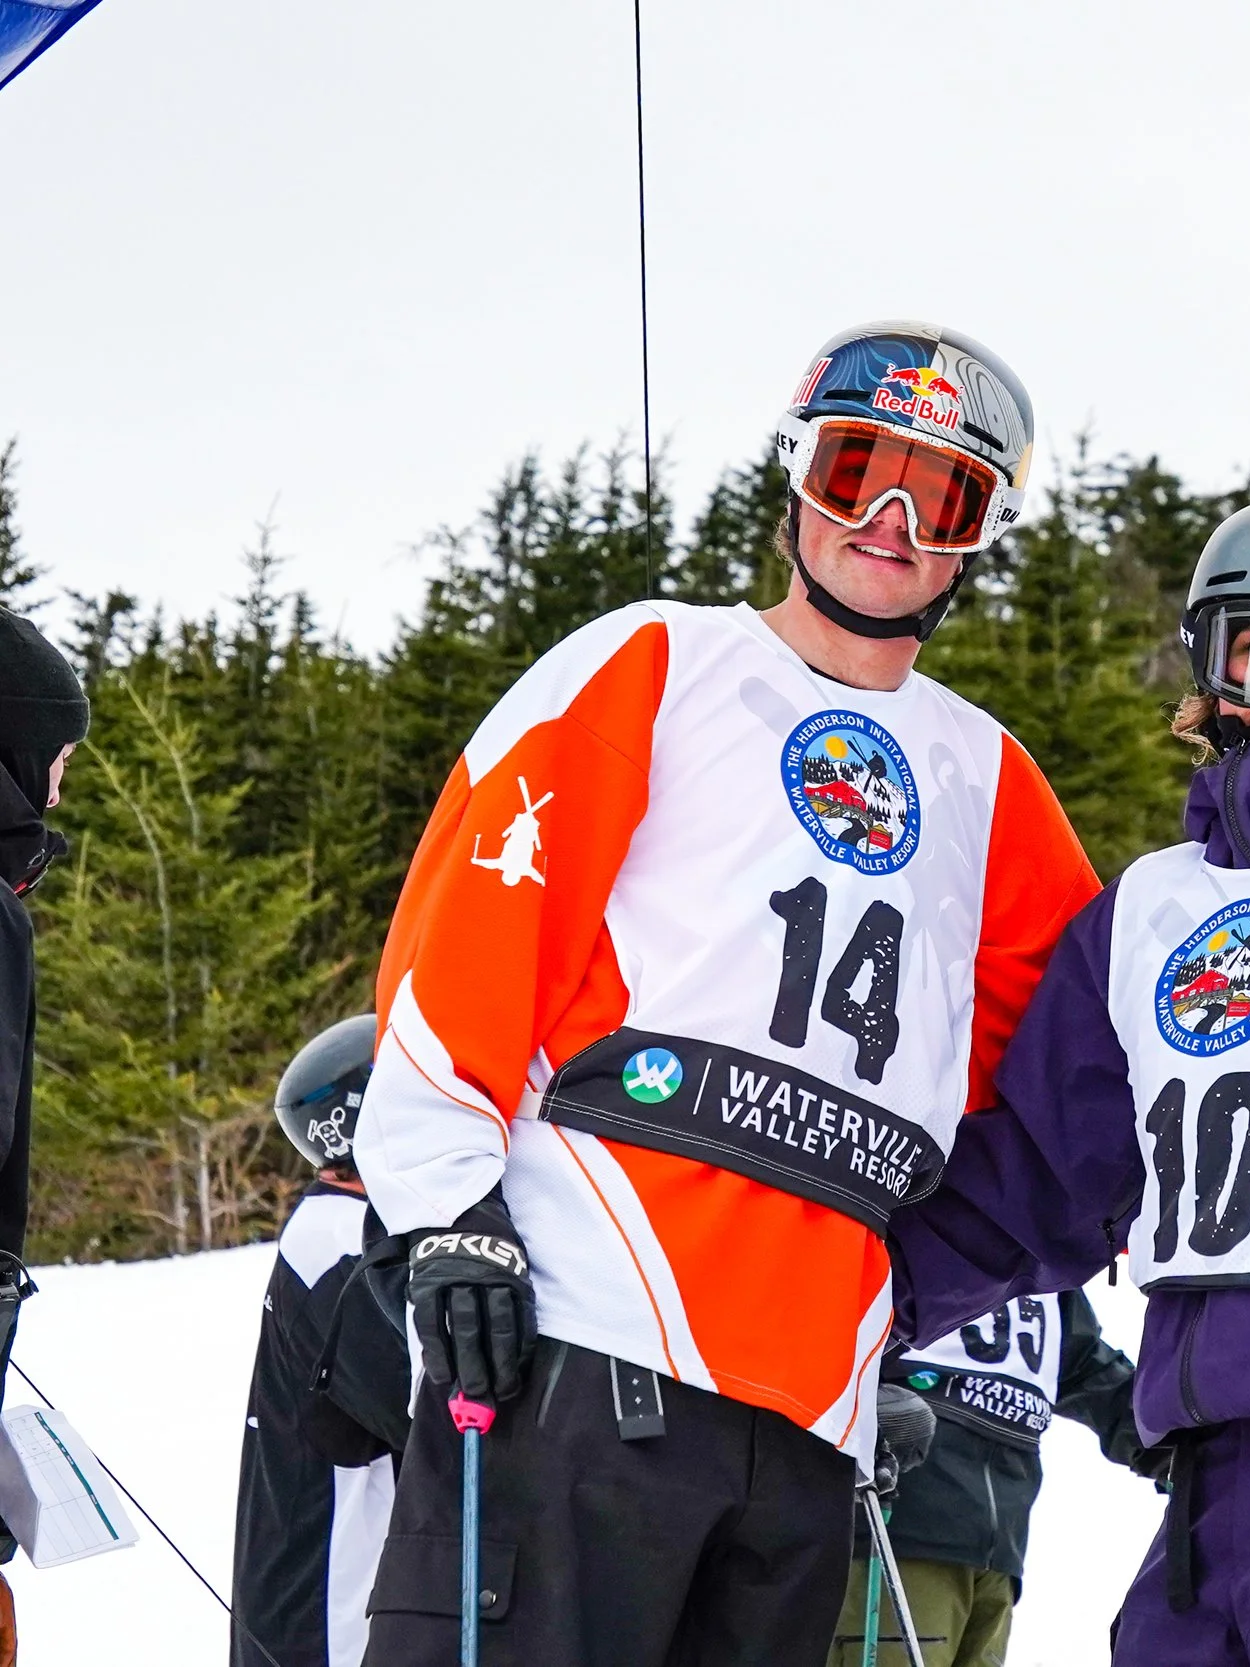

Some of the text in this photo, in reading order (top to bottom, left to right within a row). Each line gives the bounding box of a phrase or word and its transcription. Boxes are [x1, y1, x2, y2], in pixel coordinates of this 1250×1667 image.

[873, 388, 960, 431] Red Bull
[787, 714, 917, 810] THE HENDERSON INVITATIONAL
[790, 786, 917, 871] WATERVILLE VALLEY RESORT
[769, 876, 904, 1086] 14
[1165, 953, 1185, 978] THE
[1158, 995, 1201, 1052] WATERVILLE
[1204, 1025, 1247, 1052] VALLEY
[720, 1098, 841, 1161] VALLEY
[416, 1233, 527, 1276] OAKLEY
[960, 1388, 1026, 1423] VALLEY
